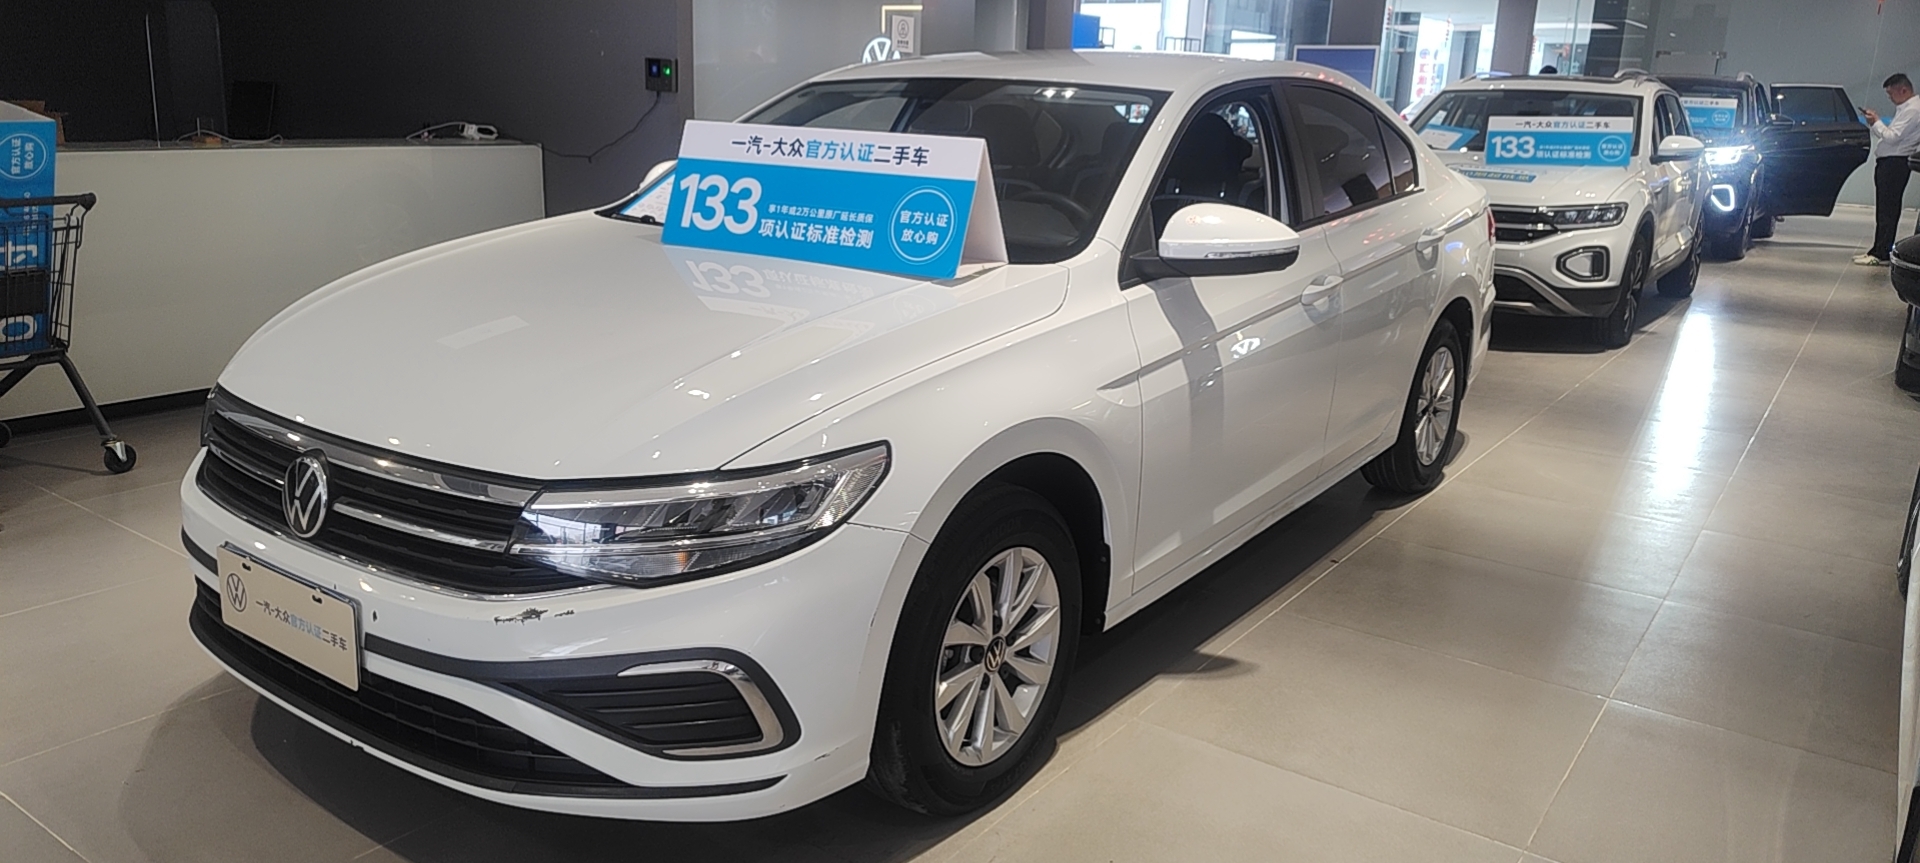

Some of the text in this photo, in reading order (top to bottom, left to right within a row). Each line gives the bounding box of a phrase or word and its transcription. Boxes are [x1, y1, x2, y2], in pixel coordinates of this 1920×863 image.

[1515, 120, 1611, 129] 一汽-大众官方认证二手车
[11, 138, 21, 175] 官方认证
[731, 135, 930, 168] 一汽-大众官方认证二手车
[1491, 135, 1536, 159] 133
[679, 173, 762, 235] 133
[900, 210, 949, 228] 官方认证
[758, 218, 874, 249] 项认证标准检测
[901, 228, 939, 246] 放心购
[255, 600, 348, 652] 一汽-大众官方认证二手车
